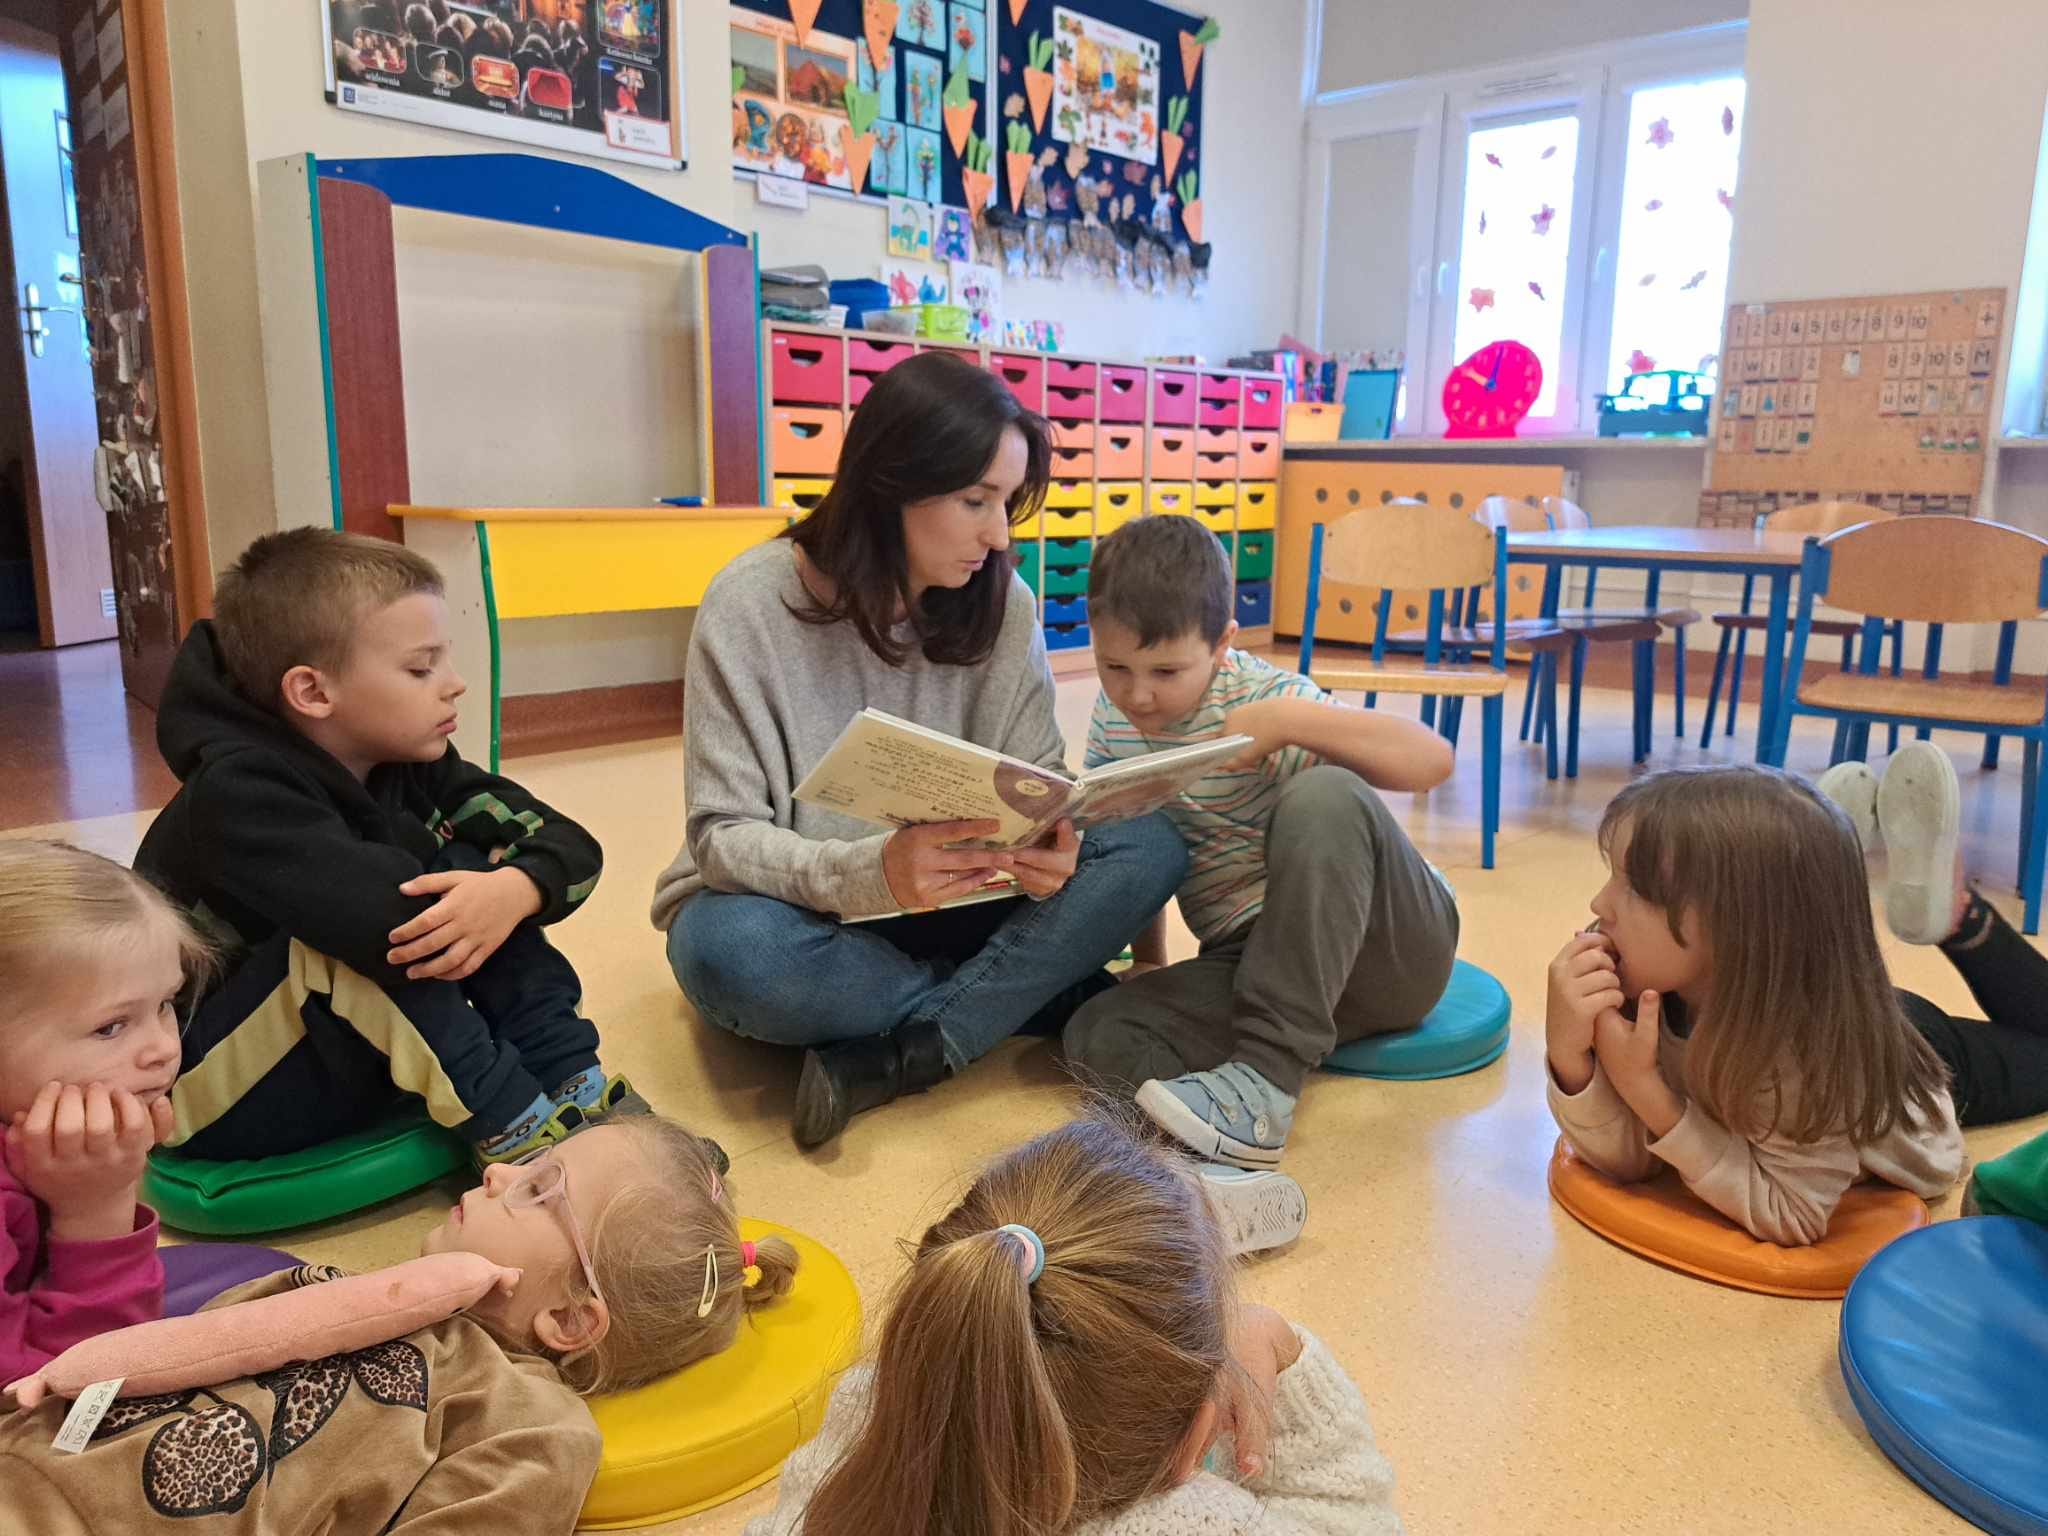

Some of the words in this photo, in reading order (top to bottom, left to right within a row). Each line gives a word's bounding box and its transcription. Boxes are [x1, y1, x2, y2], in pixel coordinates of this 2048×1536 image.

[1810, 320, 1821, 334] 5
[1849, 317, 1861, 334] 7
[1871, 315, 1882, 332] 8
[1894, 313, 1904, 329] 9
[1911, 315, 1928, 330] 10
[1887, 353, 1898, 369] 8
[1911, 351, 1922, 367] 9
[1927, 351, 1946, 367] 10
[1973, 348, 1991, 366] M
